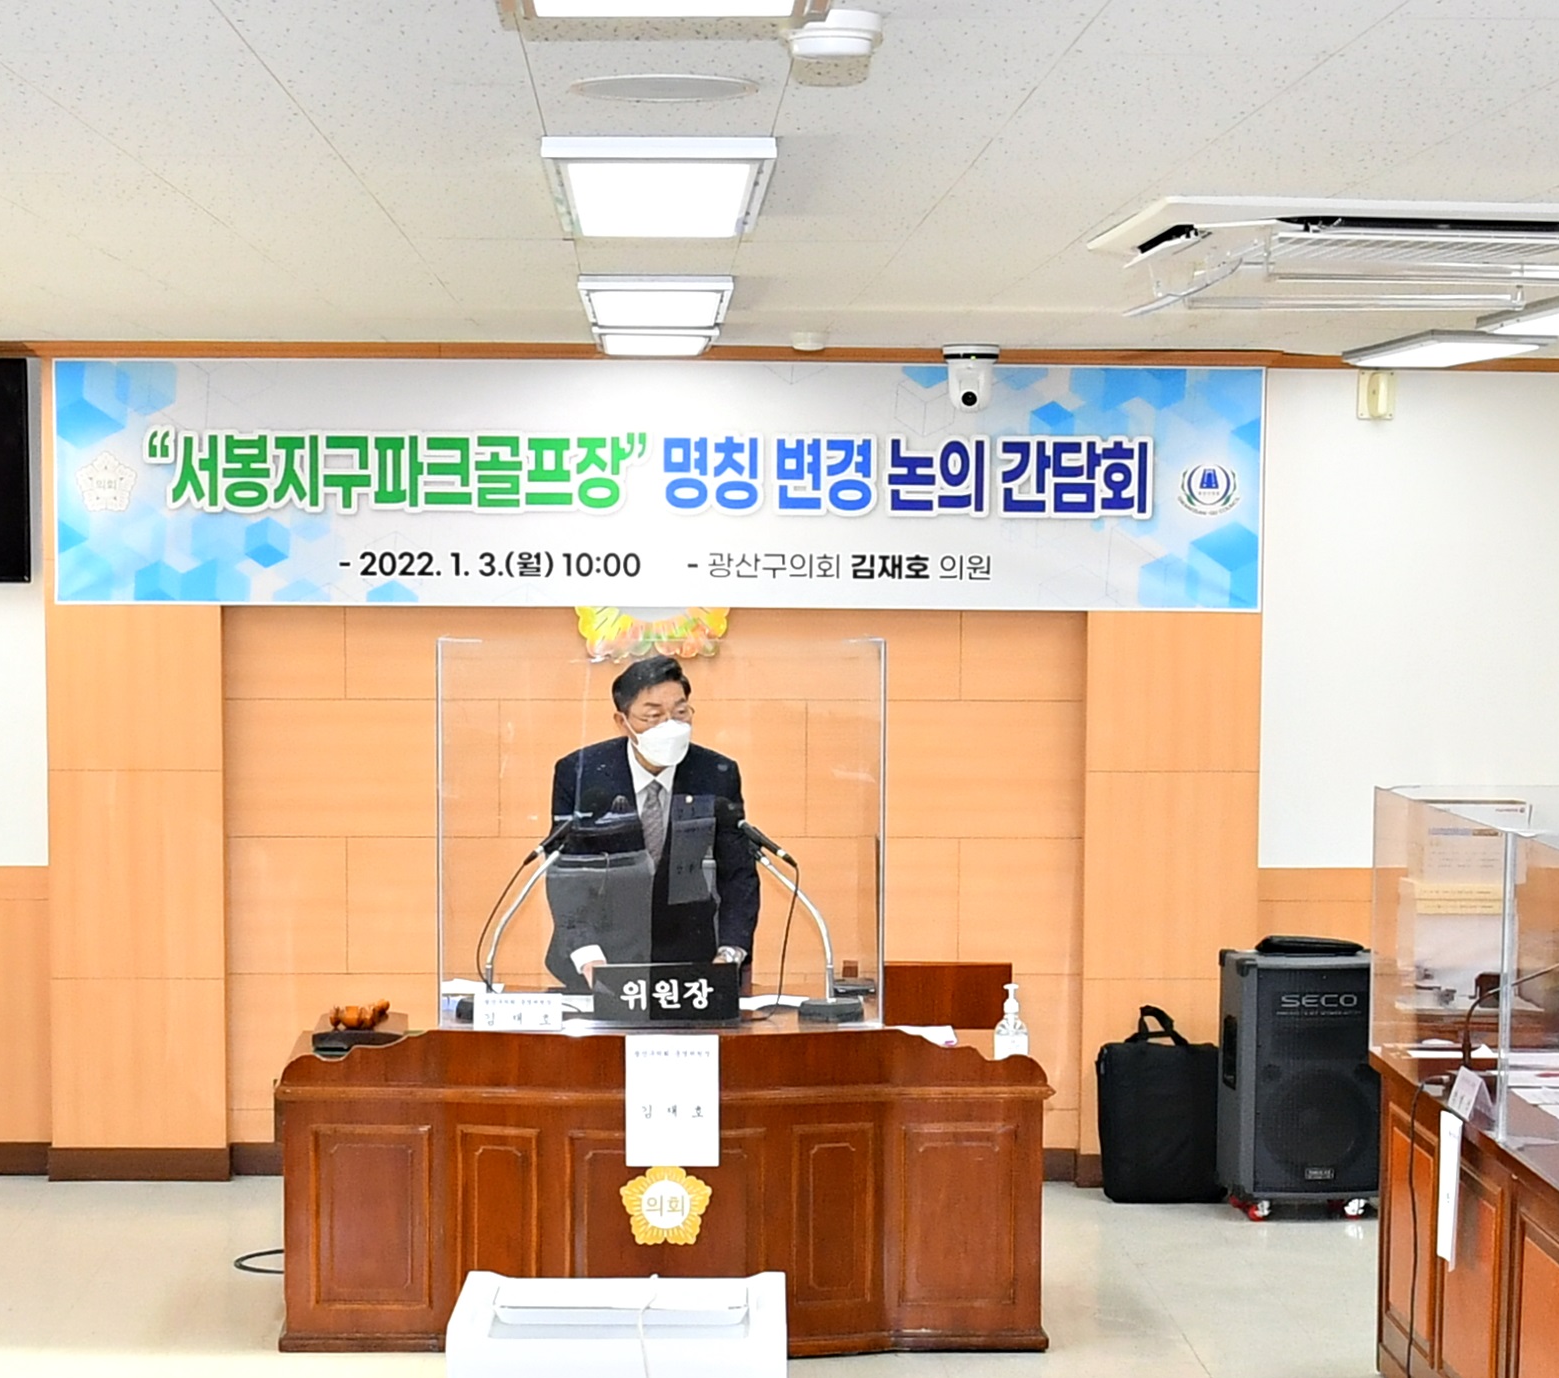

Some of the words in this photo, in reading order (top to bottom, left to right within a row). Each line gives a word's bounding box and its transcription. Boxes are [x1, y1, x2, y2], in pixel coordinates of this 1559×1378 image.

[148, 430, 646, 509] “서봉지구파크골프장”
[663, 436, 758, 510] 명칭
[777, 437, 872, 511] 변경
[888, 438, 985, 513] 논의
[1001, 440, 1149, 514] 간담회
[359, 551, 441, 577] 2022.
[450, 552, 469, 577] 1.
[478, 550, 554, 578] 3.(월)
[562, 552, 641, 578] 10:00
[708, 552, 840, 579] 광산구의회
[851, 553, 930, 580] 김재호
[939, 554, 991, 581] 의원
[620, 978, 714, 1011] 위원장
[1281, 994, 1358, 1007] SECO
[645, 1195, 685, 1217] 의회
